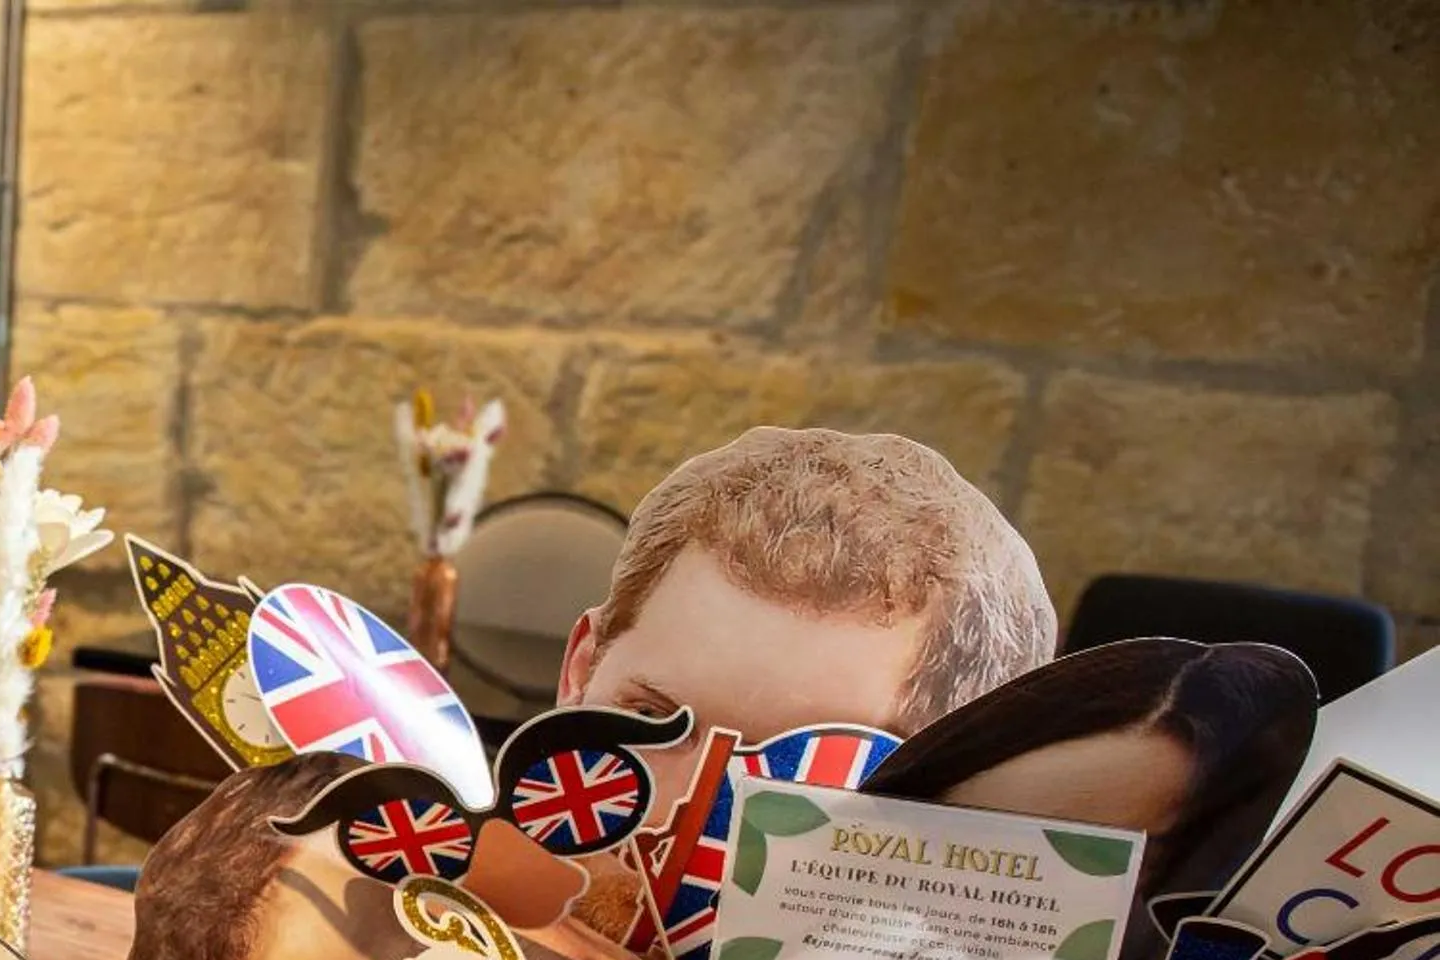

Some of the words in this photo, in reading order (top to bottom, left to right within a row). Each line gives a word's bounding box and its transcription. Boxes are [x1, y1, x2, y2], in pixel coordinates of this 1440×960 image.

[830, 826, 933, 866] ROYAL
[943, 841, 1044, 881] HOTEL
[784, 886, 816, 899] vous
[819, 890, 864, 905] convie
[868, 898, 898, 912] tous
[902, 902, 922, 915] les
[968, 913, 986, 925] de
[991, 916, 1015, 931] 16h
[790, 859, 879, 885] L'ÉQUIPE
[885, 874, 914, 890] DU
[917, 879, 984, 902] ROYAL
[989, 889, 1061, 913] HÔTEL
[779, 901, 825, 916] autour
[828, 907, 867, 922] d'une
[953, 928, 982, 941] une
[984, 933, 1057, 952] ambiance
